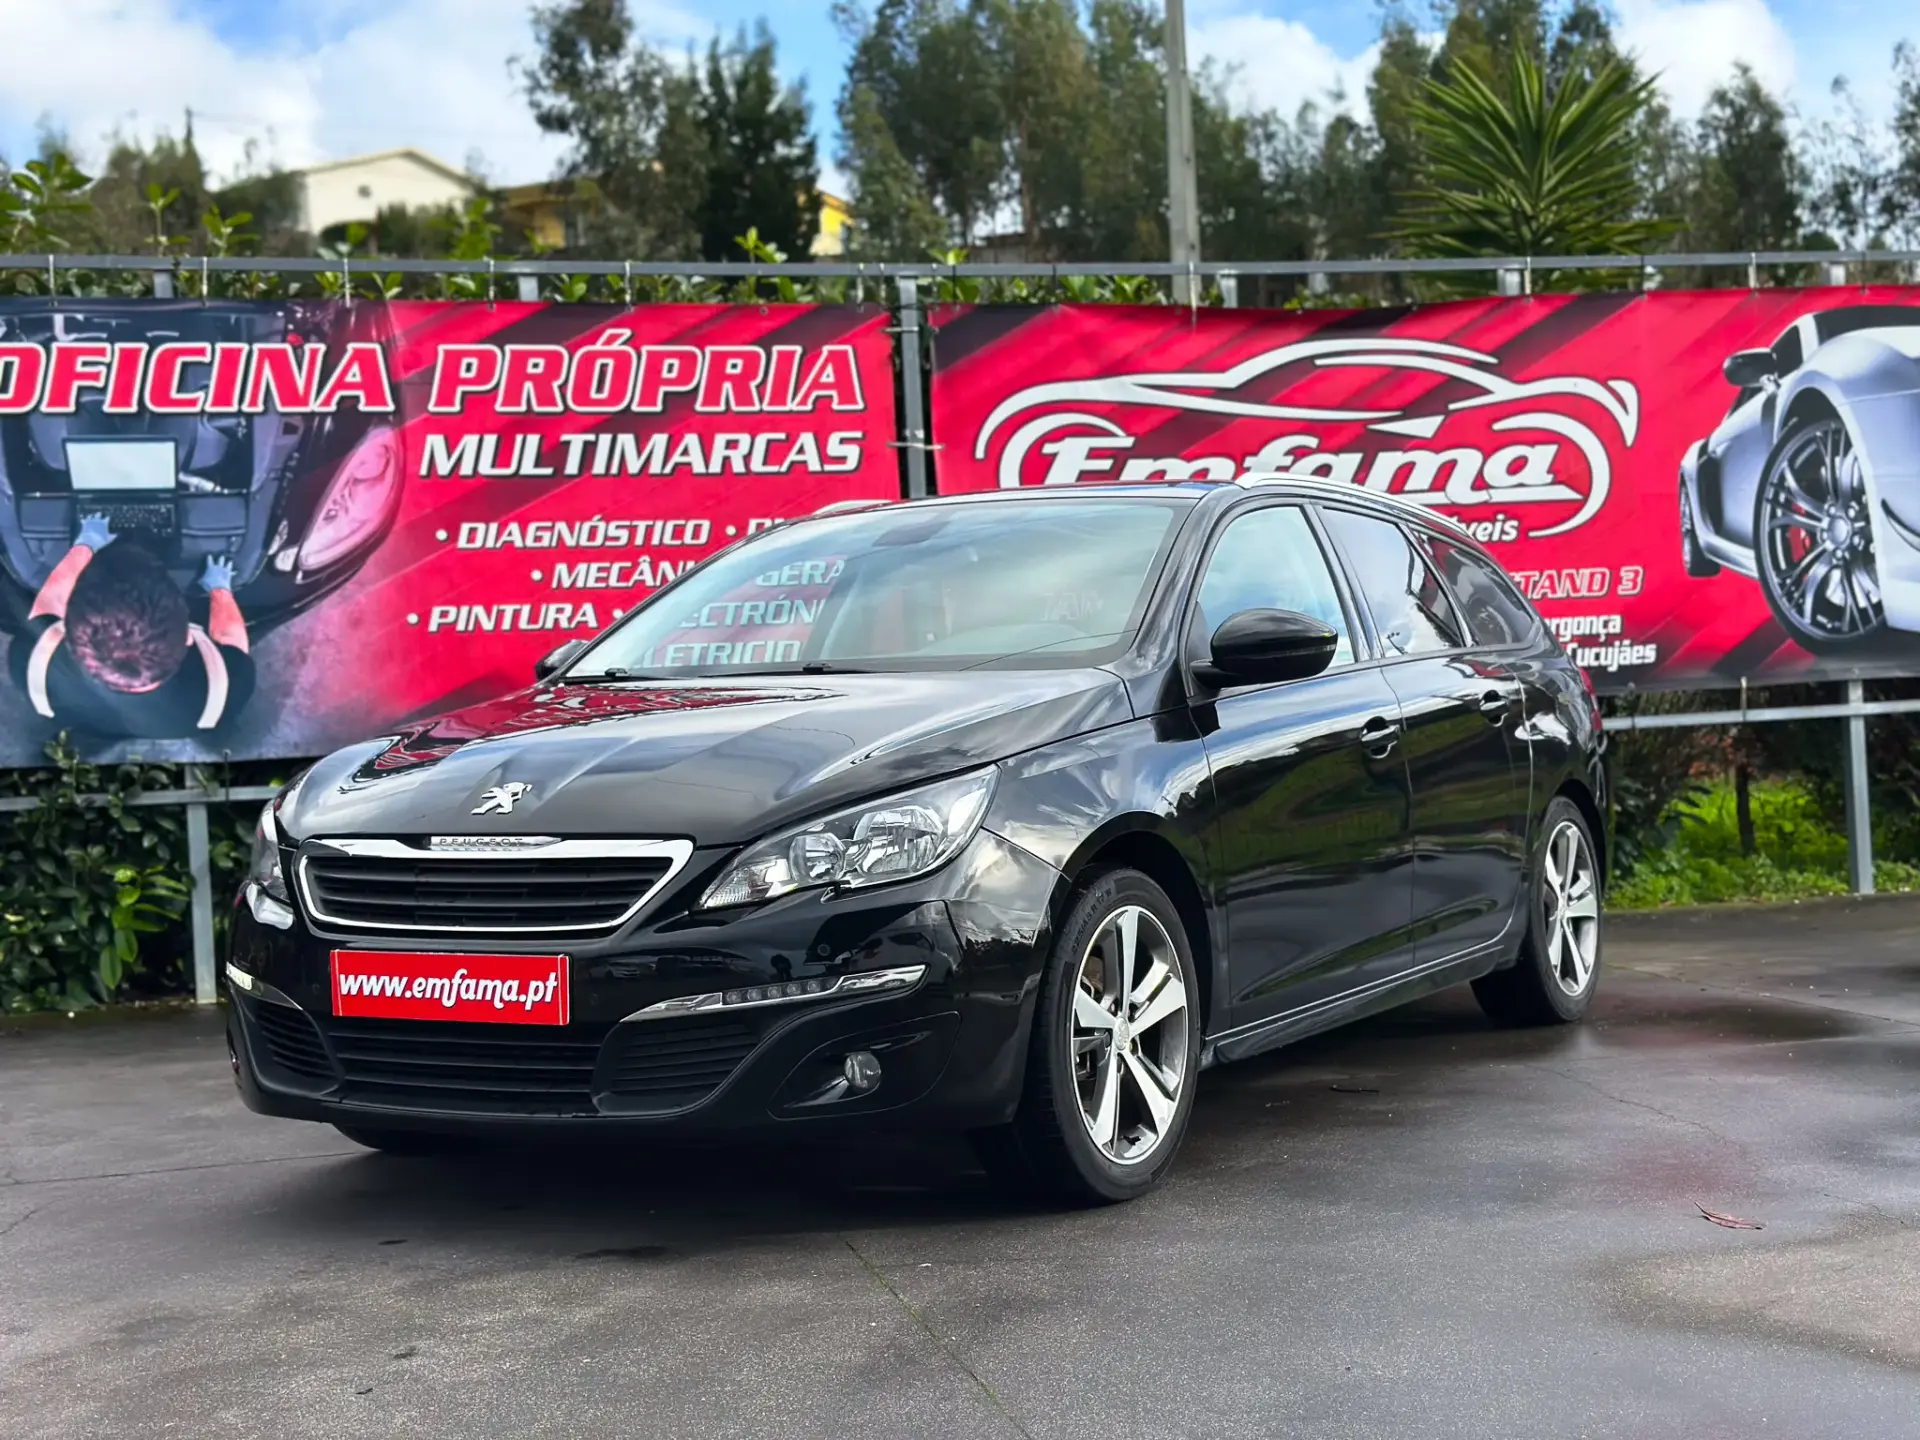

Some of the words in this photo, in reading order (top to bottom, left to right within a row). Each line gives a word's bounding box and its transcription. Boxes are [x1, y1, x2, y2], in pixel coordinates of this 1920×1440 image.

[0, 342, 395, 412] OFICINA
[427, 329, 865, 413] PRÓPRIA
[419, 431, 864, 477] MULTIMARCAS
[457, 514, 711, 549] DIAGNÓSTICO
[1450, 513, 1519, 542] veis
[1508, 568, 1610, 600] TAND
[1617, 565, 1644, 596] 3
[427, 602, 598, 633] PINTURA
[1544, 614, 1622, 642] rgonça
[439, 837, 523, 847] PEUGEOT
[339, 968, 558, 1011] www.emfama.pt
